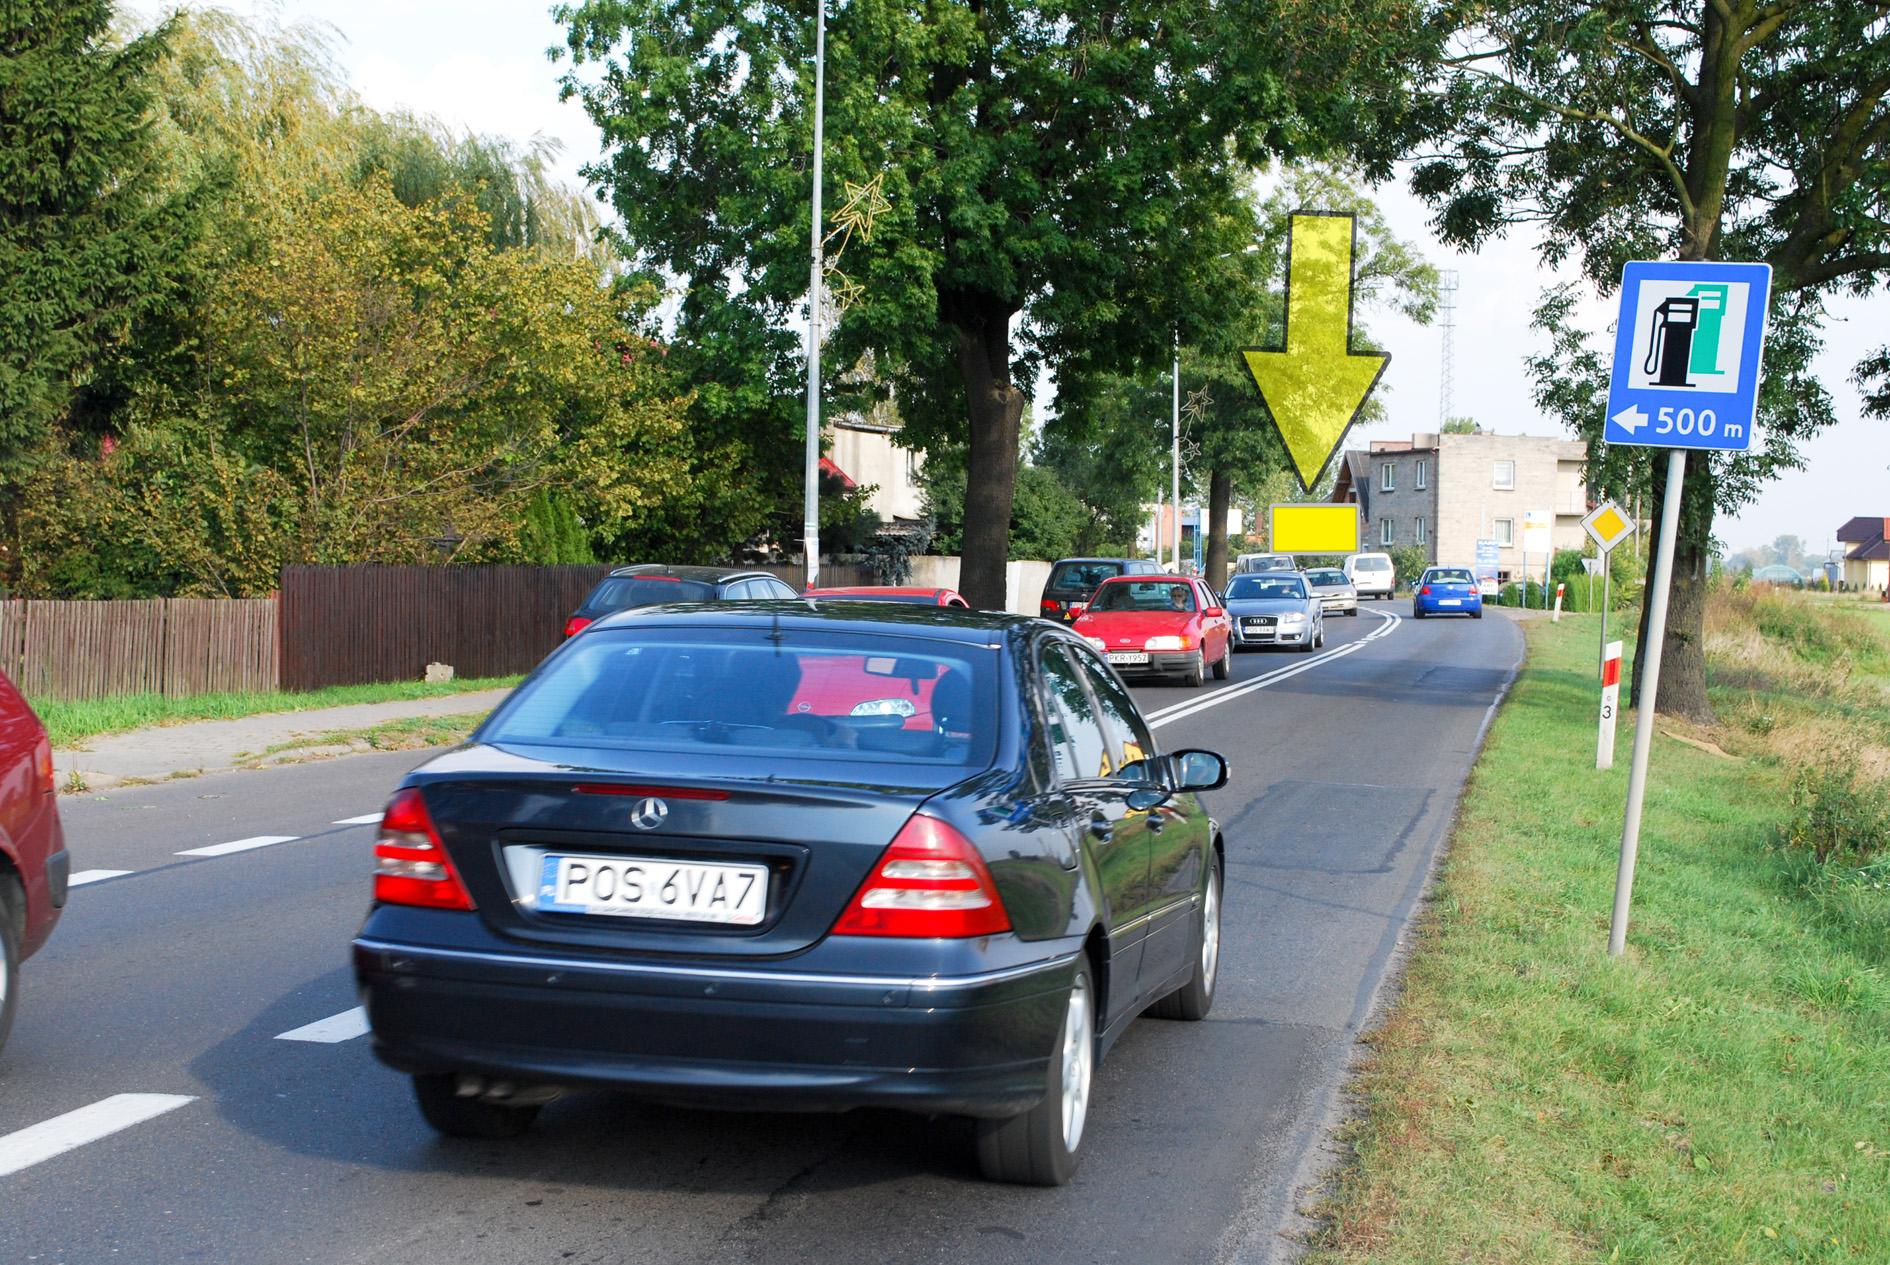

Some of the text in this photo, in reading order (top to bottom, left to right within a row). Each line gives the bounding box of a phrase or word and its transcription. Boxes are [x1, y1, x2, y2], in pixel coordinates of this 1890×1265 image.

[1656, 407, 1743, 438] 500 m
[1602, 705, 1611, 719] 3
[563, 864, 756, 910] POS 6VA7
